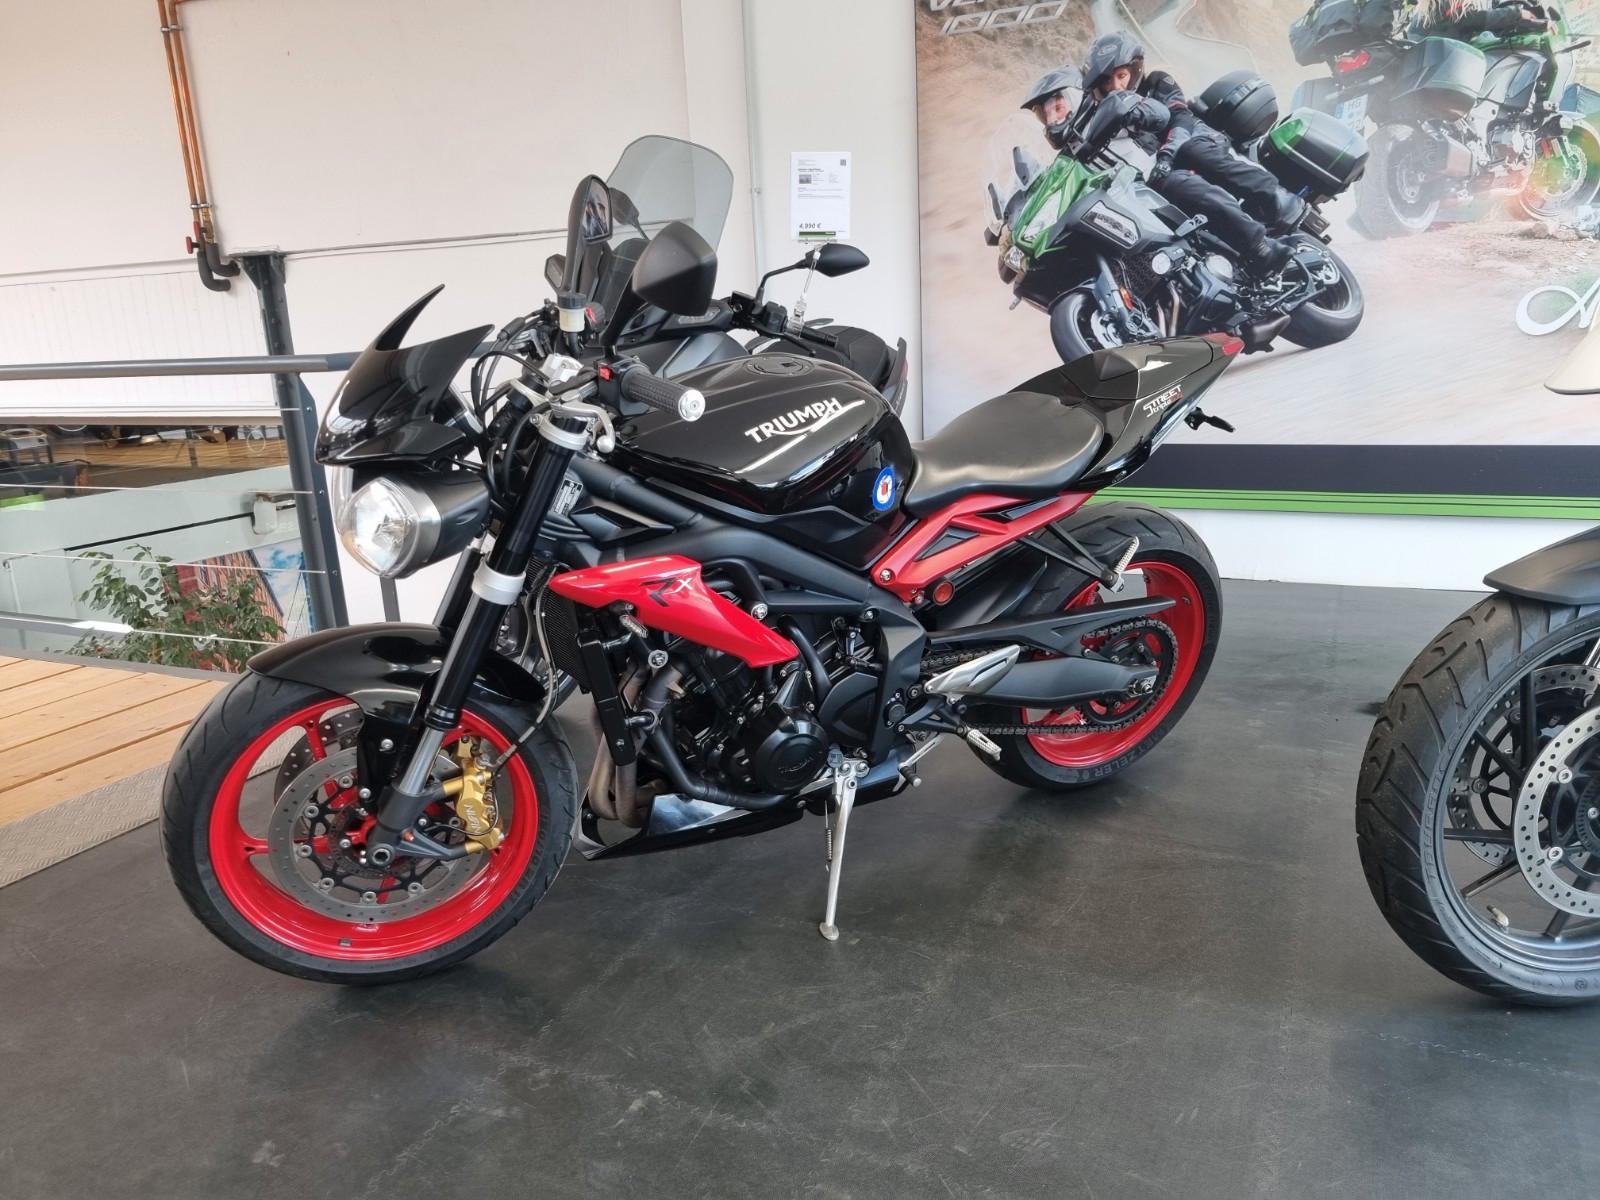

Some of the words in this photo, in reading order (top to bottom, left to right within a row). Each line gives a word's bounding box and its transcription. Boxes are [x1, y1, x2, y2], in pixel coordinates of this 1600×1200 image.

[939, 0, 1069, 35] 1000
[1143, 384, 1182, 418] STREET
[745, 397, 843, 443] TRIUMPH
